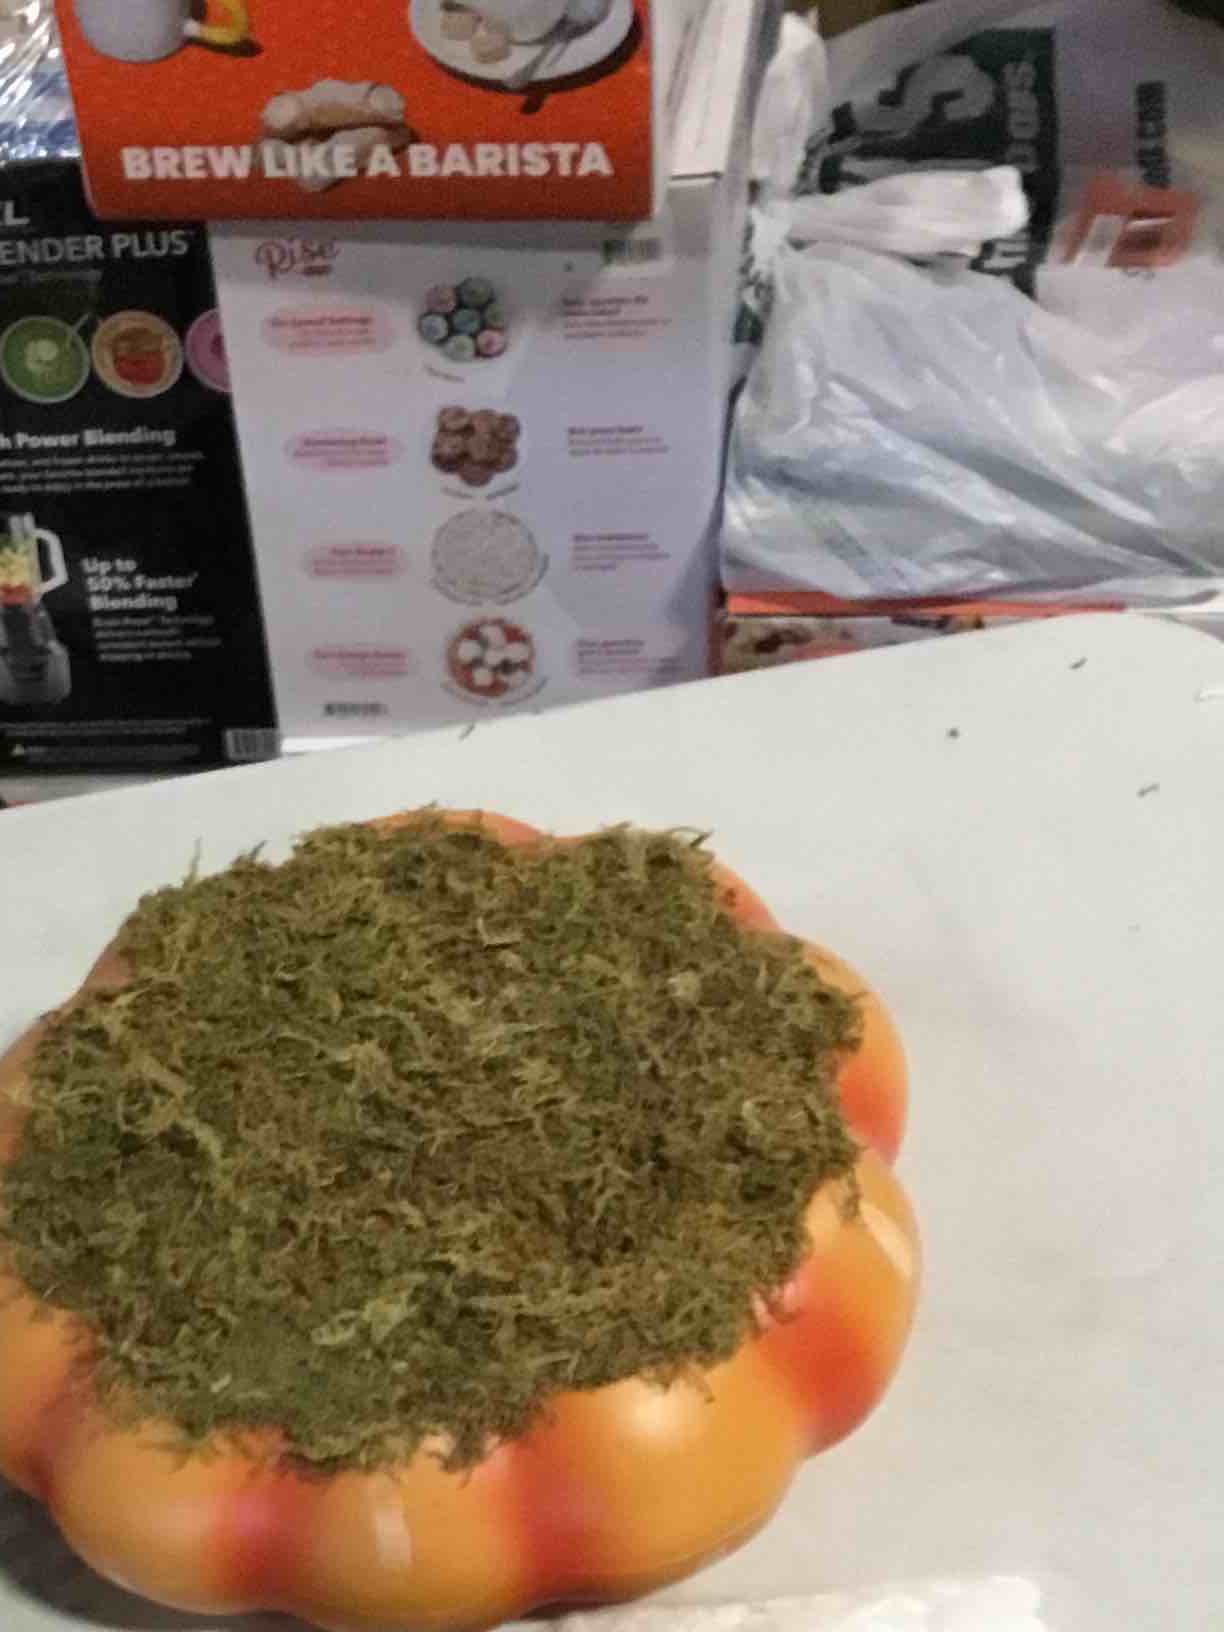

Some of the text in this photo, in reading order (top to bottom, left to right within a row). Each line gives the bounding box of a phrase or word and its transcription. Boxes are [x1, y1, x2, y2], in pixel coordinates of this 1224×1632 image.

[120, 142, 613, 179] BREW LIKE A BARISTA
[111, 230, 189, 258] PLUS
[15, 431, 80, 448] Power
[83, 426, 176, 447] Blending
[81, 557, 136, 575] Up to
[86, 575, 132, 592] 50%
[90, 593, 179, 612] Blending
